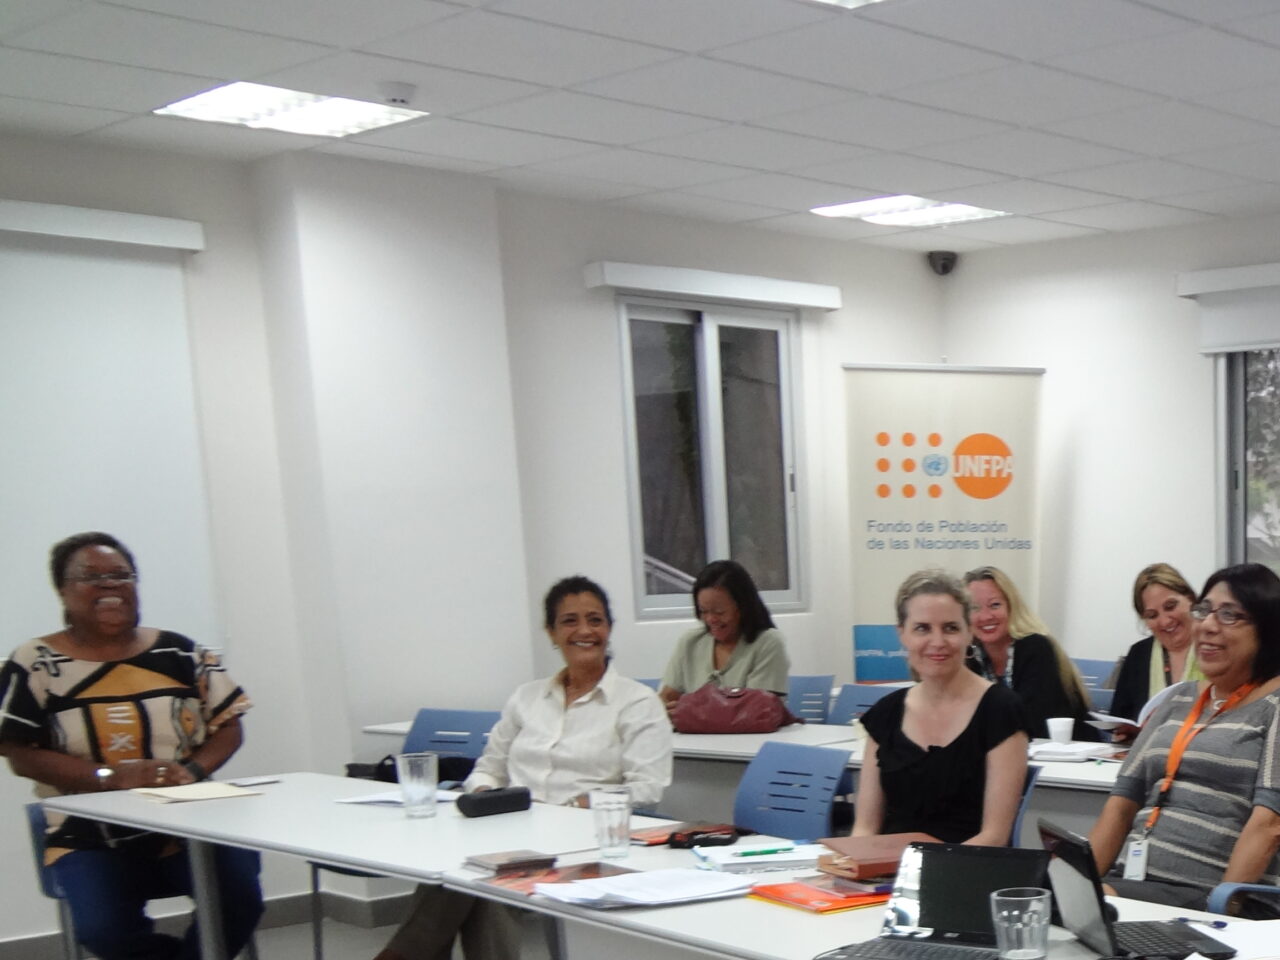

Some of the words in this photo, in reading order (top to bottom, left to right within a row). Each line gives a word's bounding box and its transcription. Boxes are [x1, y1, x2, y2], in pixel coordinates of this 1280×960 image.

[951, 454, 1016, 477] UNFPA
[866, 520, 912, 533] Fondo
[916, 520, 935, 533] de
[938, 520, 1008, 533] Población
[866, 538, 885, 550] de
[889, 538, 910, 550] las
[914, 538, 980, 550] Naciones
[984, 538, 1032, 550] Unidas
